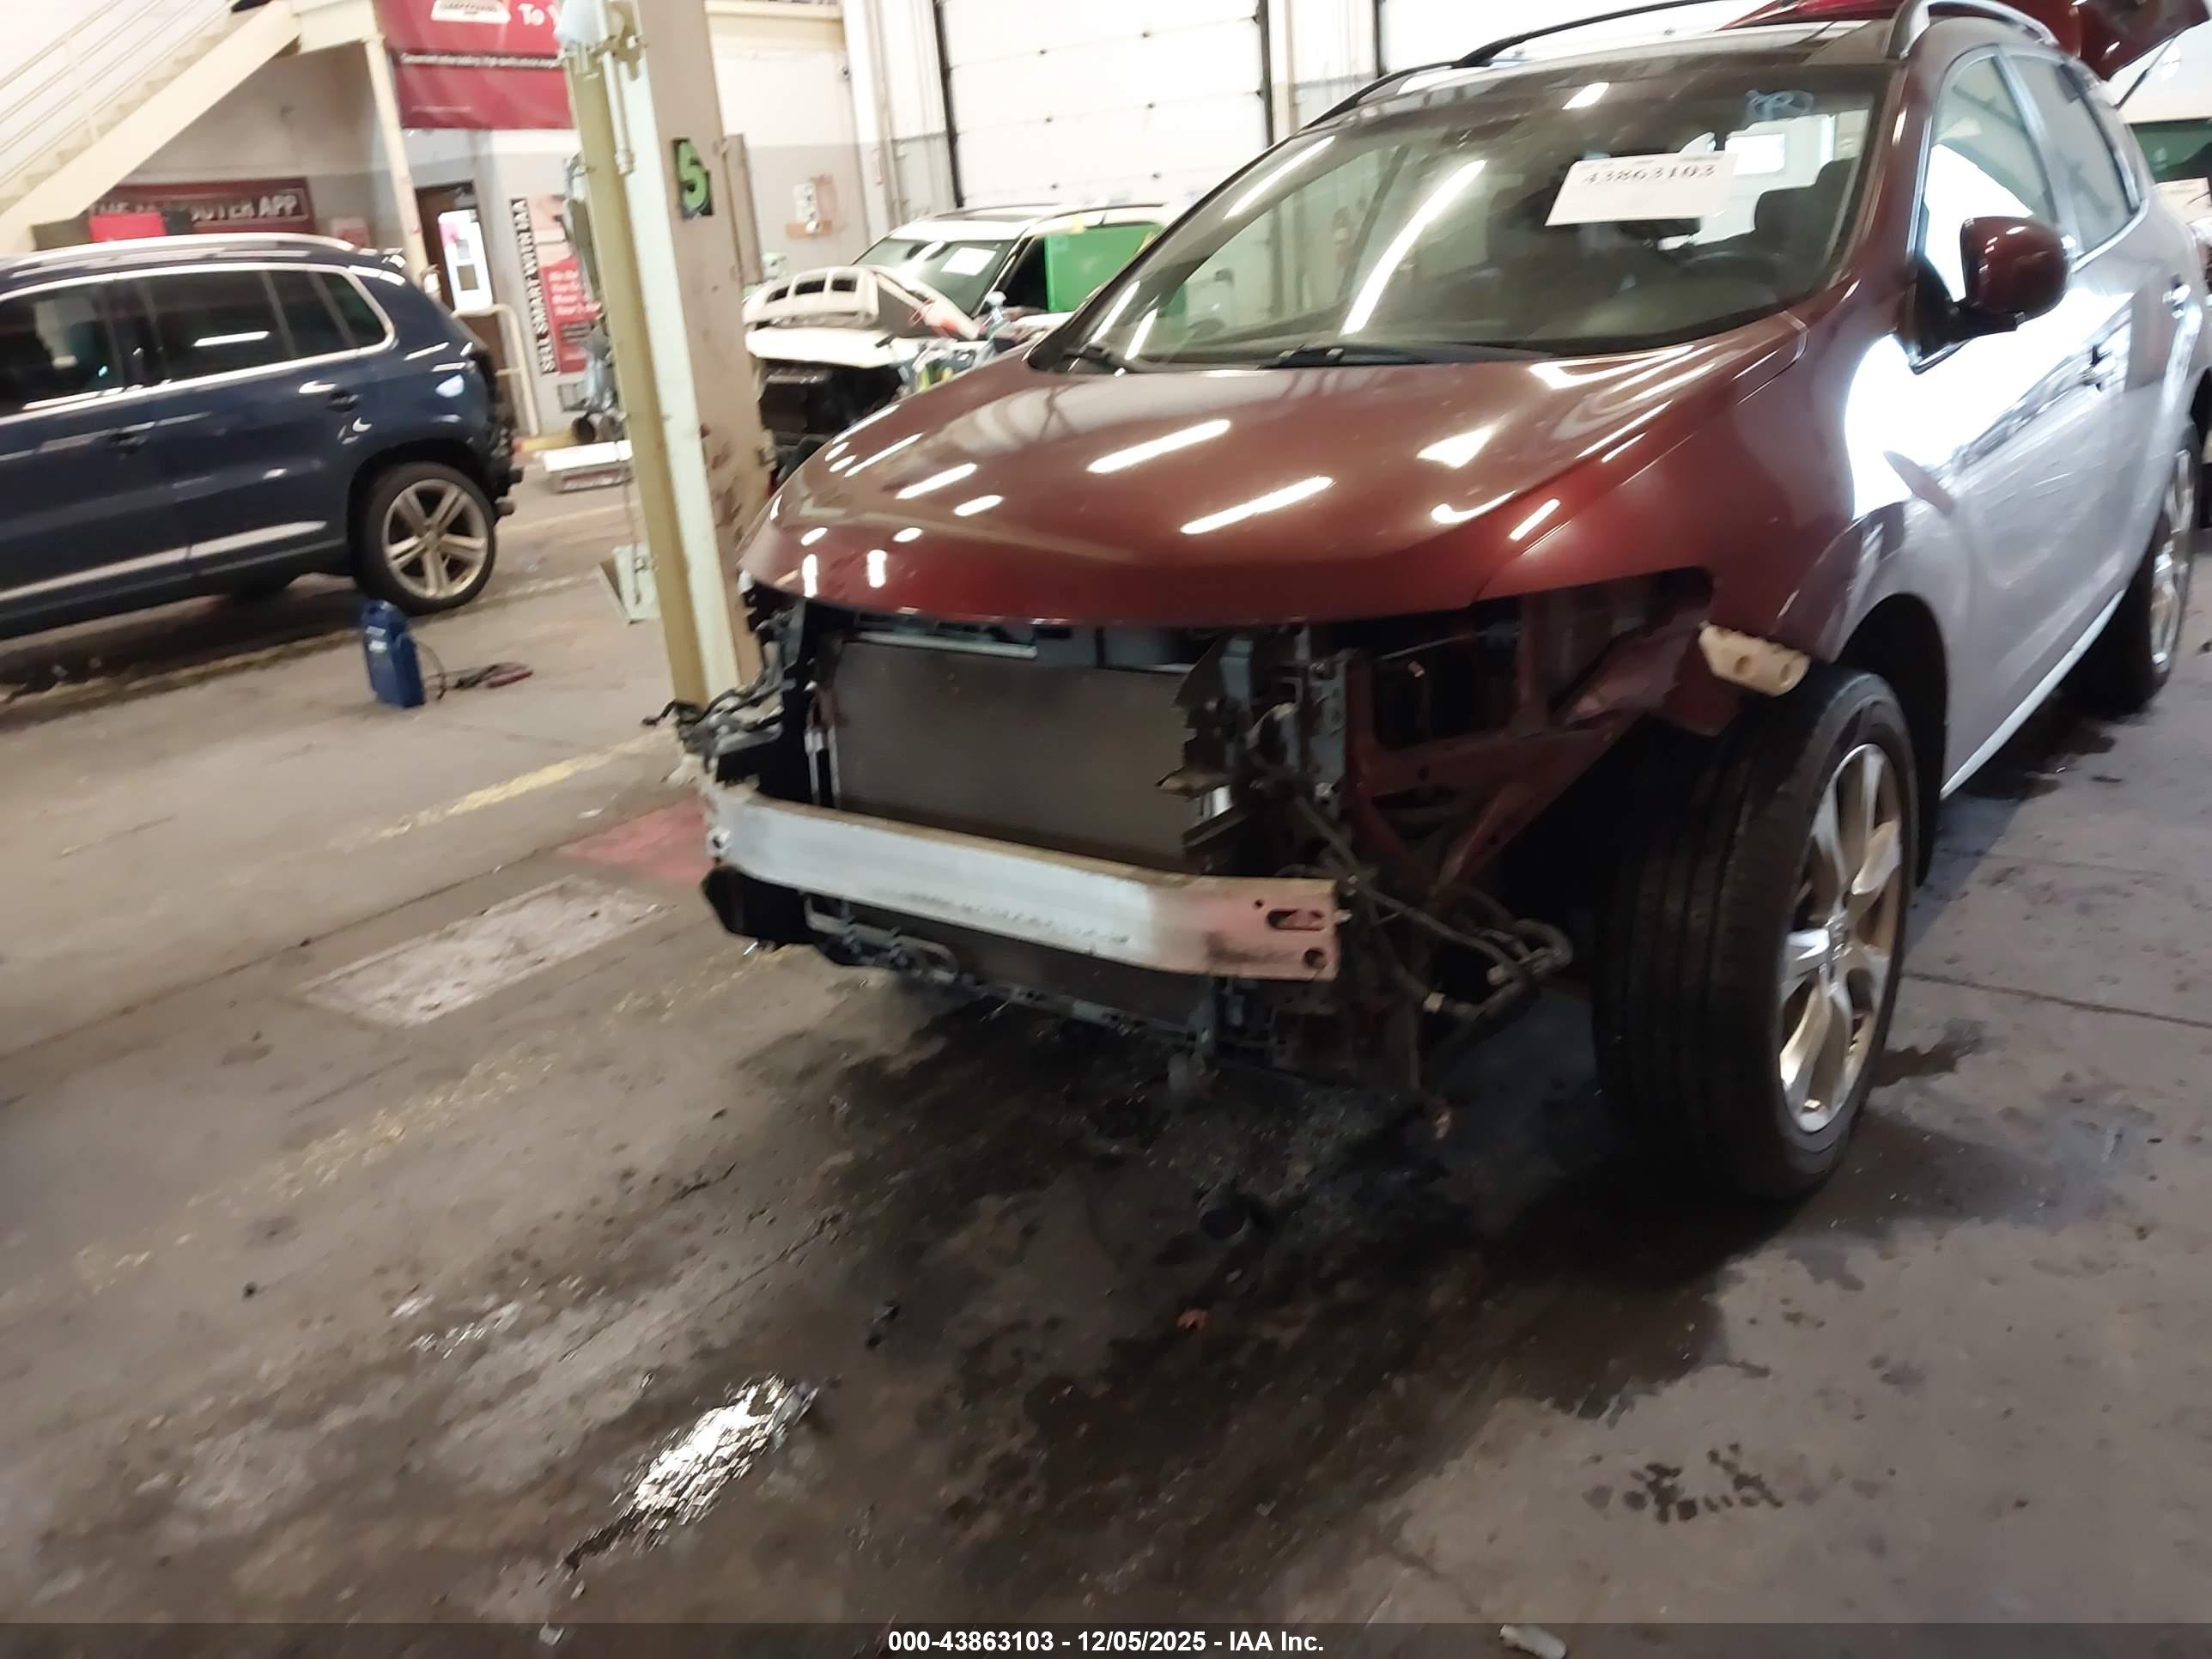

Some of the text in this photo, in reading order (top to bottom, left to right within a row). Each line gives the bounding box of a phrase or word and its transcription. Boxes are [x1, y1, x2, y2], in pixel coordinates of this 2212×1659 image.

[517, 3, 545, 27] To
[1583, 164, 1717, 185] 43863103
[258, 194, 298, 217] APP
[526, 279, 548, 333] SMART
[538, 337, 556, 371] SELL
